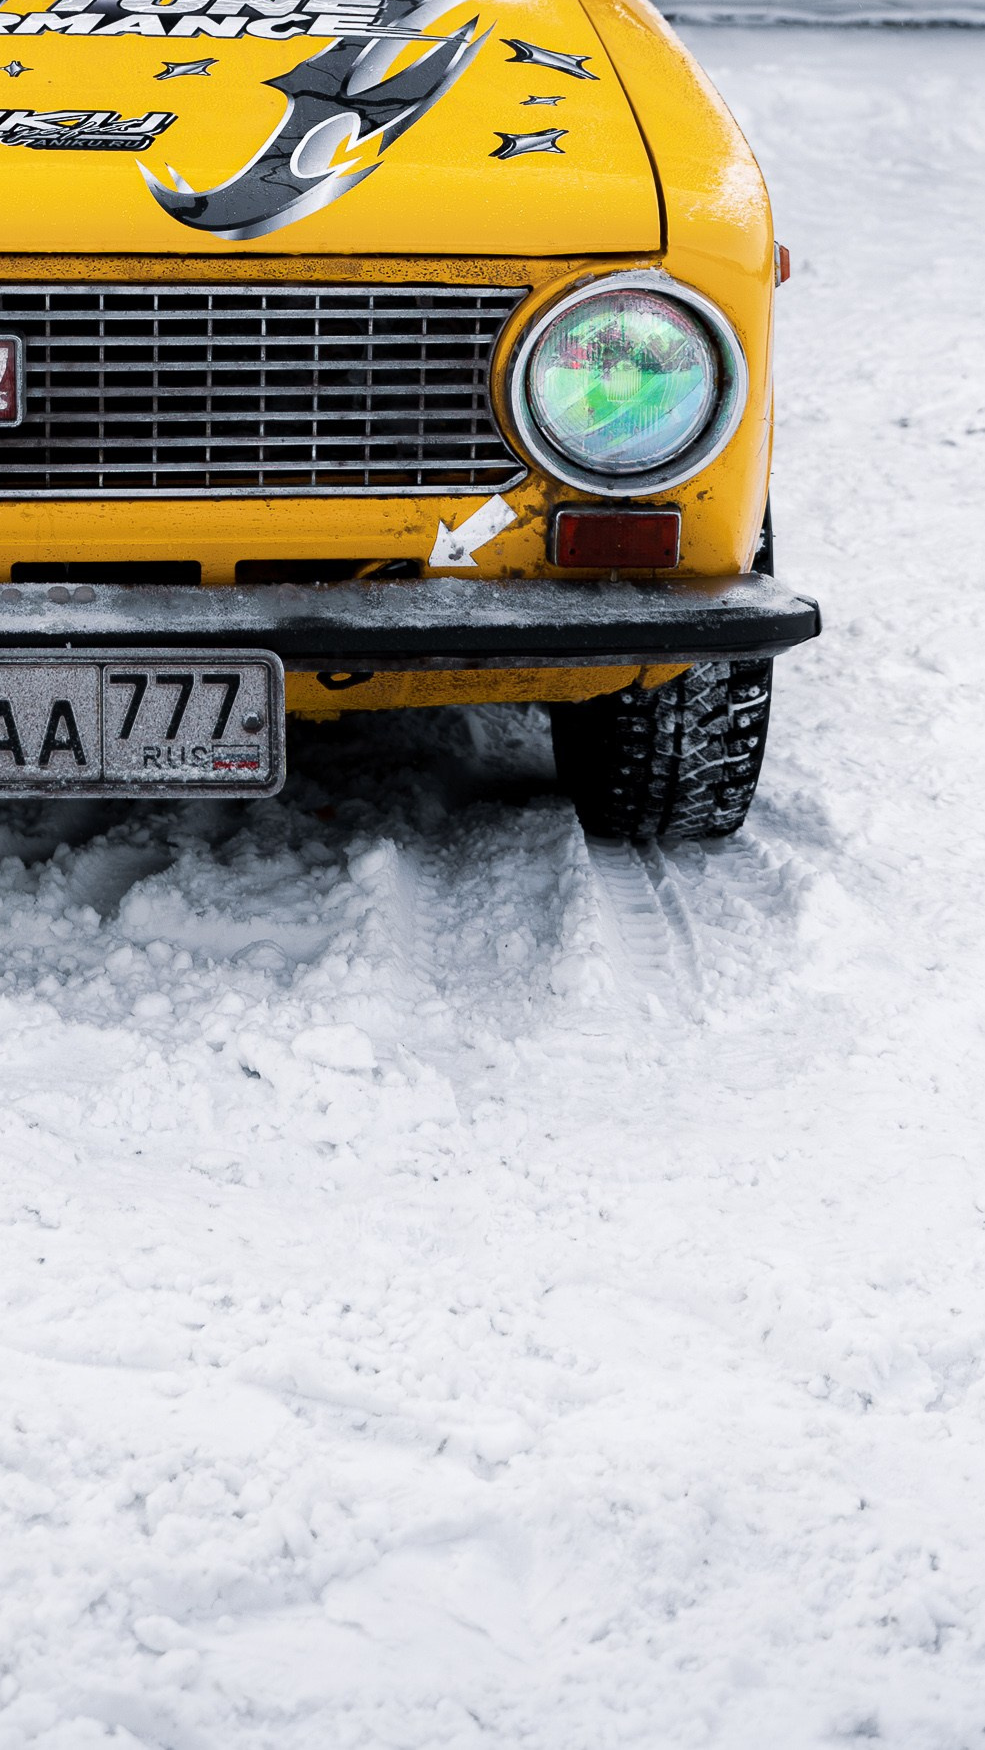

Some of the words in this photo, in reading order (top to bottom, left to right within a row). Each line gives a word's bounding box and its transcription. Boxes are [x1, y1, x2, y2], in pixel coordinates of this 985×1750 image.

[31, 139, 142, 148] ANIKU.RU
[109, 673, 242, 740] 777
[143, 746, 209, 769] RUS
